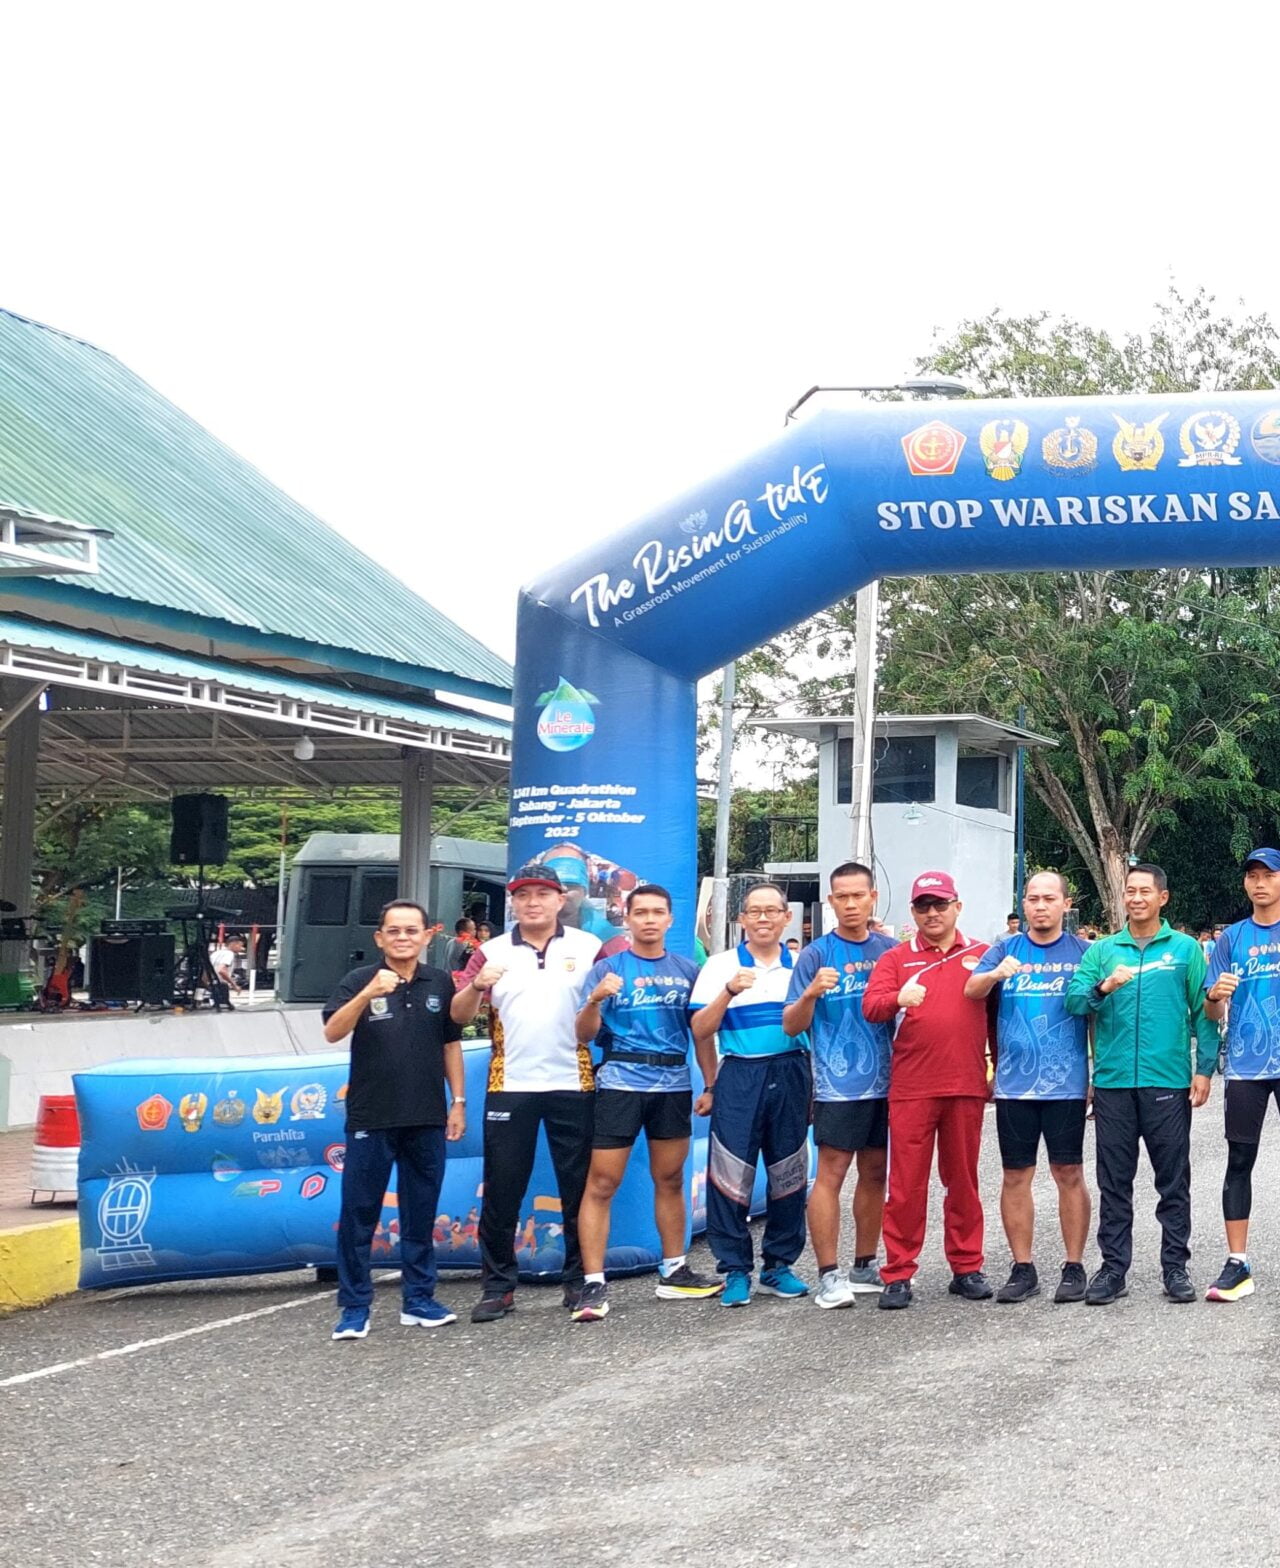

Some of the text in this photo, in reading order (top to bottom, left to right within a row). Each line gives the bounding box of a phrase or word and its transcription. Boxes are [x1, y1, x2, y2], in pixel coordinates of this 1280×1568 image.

[877, 499, 983, 531] STOP
[989, 493, 1218, 527] WARISKAN
[613, 512, 809, 628] A Grassroot Movement for Sustainability
[570, 572, 636, 628] The
[556, 711, 573, 723] Le
[538, 721, 594, 735] Minerale
[531, 785, 549, 797] km
[518, 800, 557, 812] Sabang
[566, 798, 622, 810] Jakarta
[511, 813, 565, 828] September
[574, 812, 587, 823] 5
[587, 811, 646, 824] Oktober
[544, 826, 581, 838] 2023
[252, 1129, 306, 1143] Parahita
